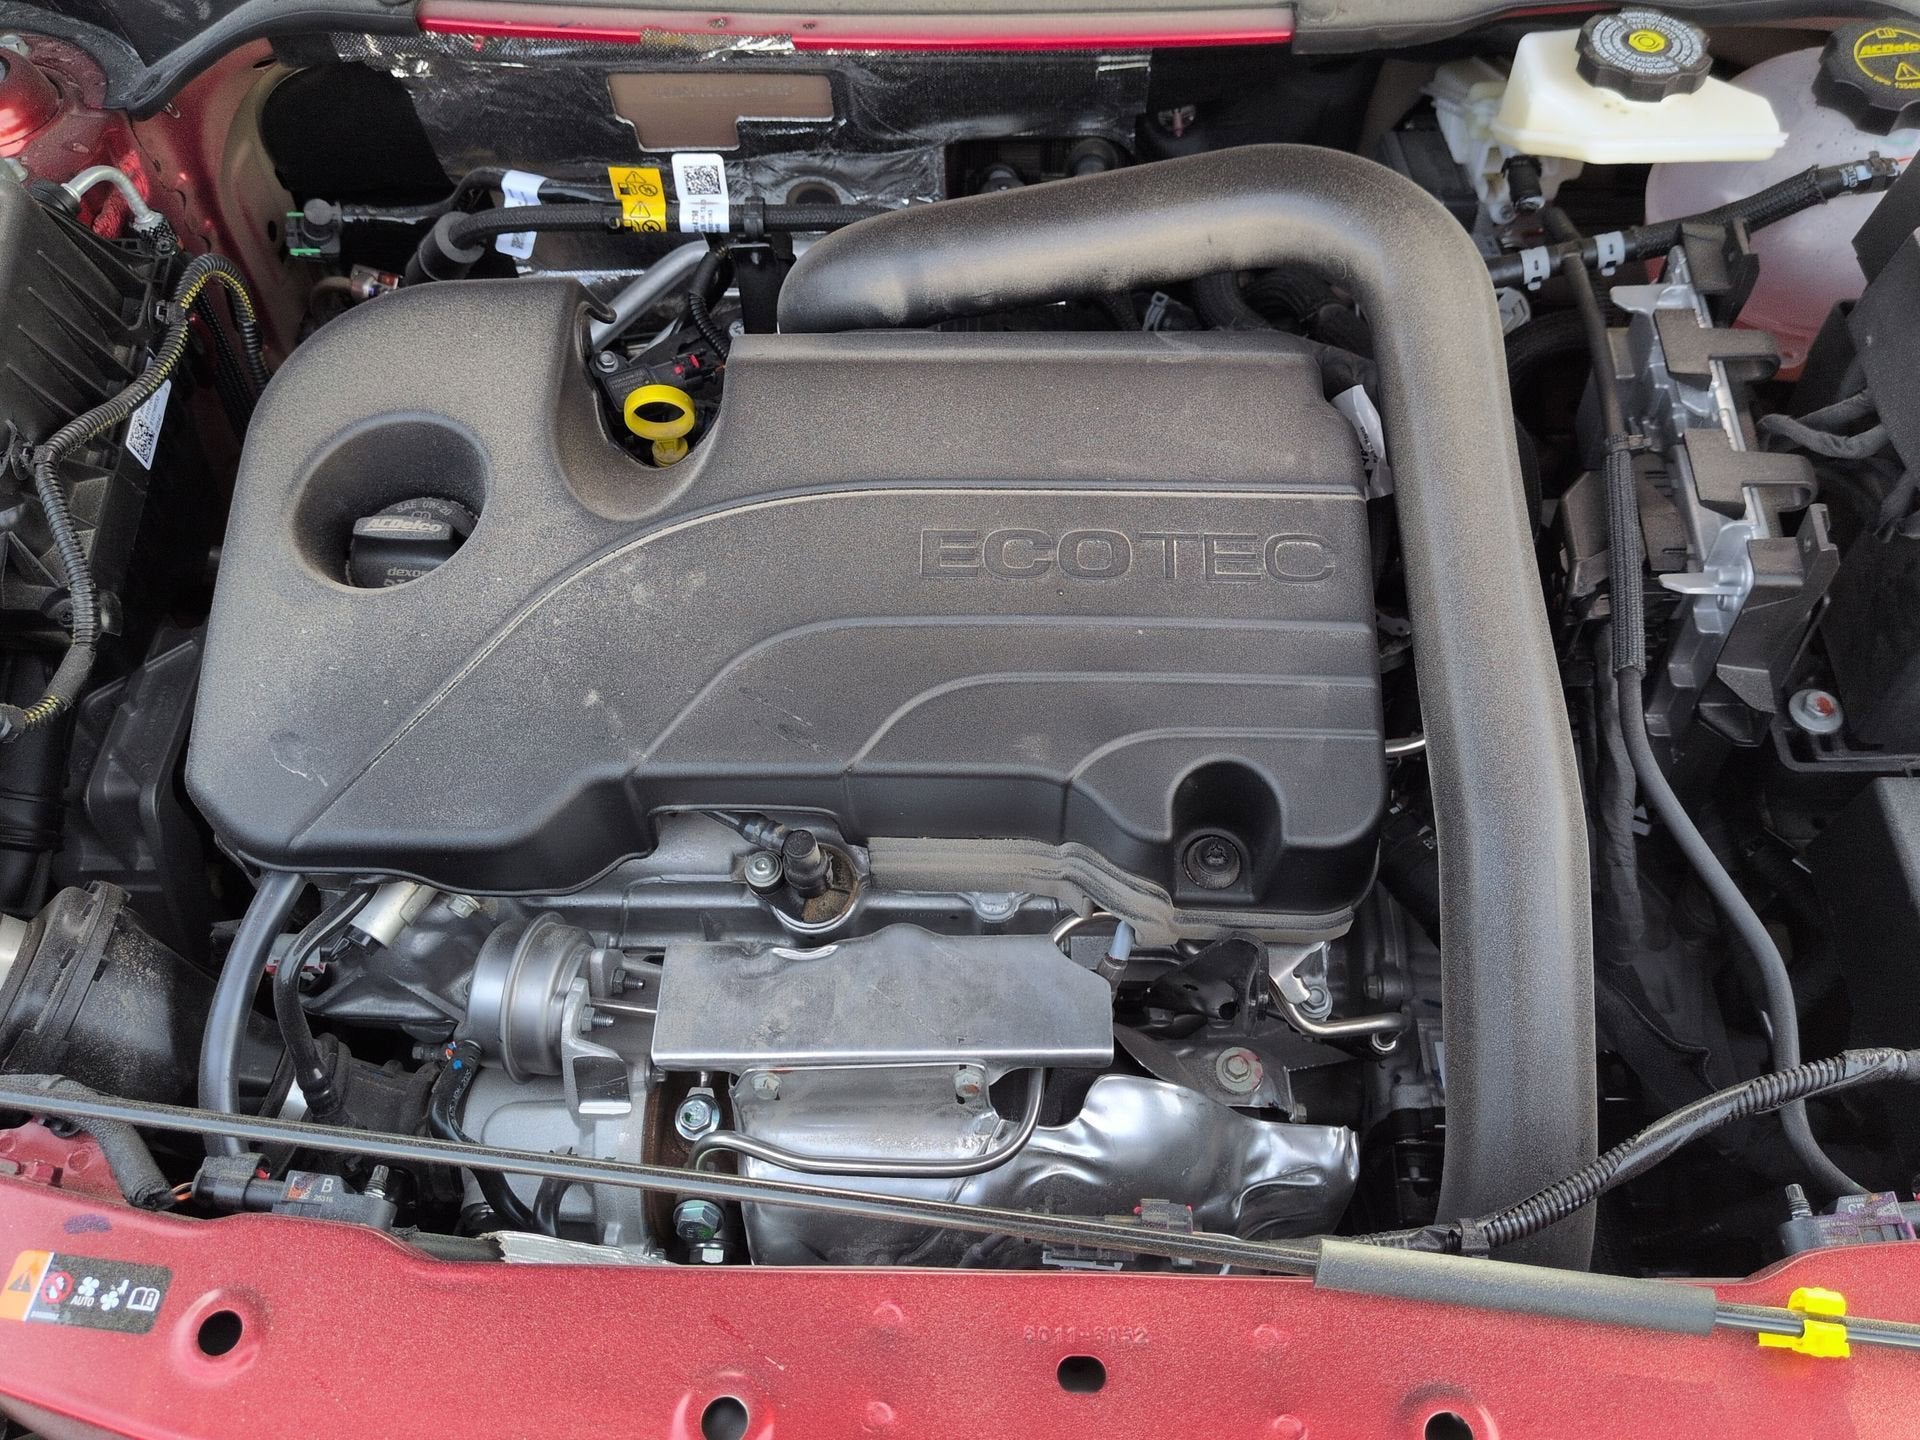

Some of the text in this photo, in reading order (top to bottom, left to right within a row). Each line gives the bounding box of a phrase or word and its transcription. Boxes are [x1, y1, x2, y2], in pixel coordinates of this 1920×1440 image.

[1860, 42, 1920, 54] ACDelc
[396, 501, 453, 516] SAE 0W-20
[368, 518, 443, 532] ACDelco
[920, 528, 1337, 584] ECOTEC
[321, 1178, 334, 1193] B
[70, 1295, 95, 1307] AUTO
